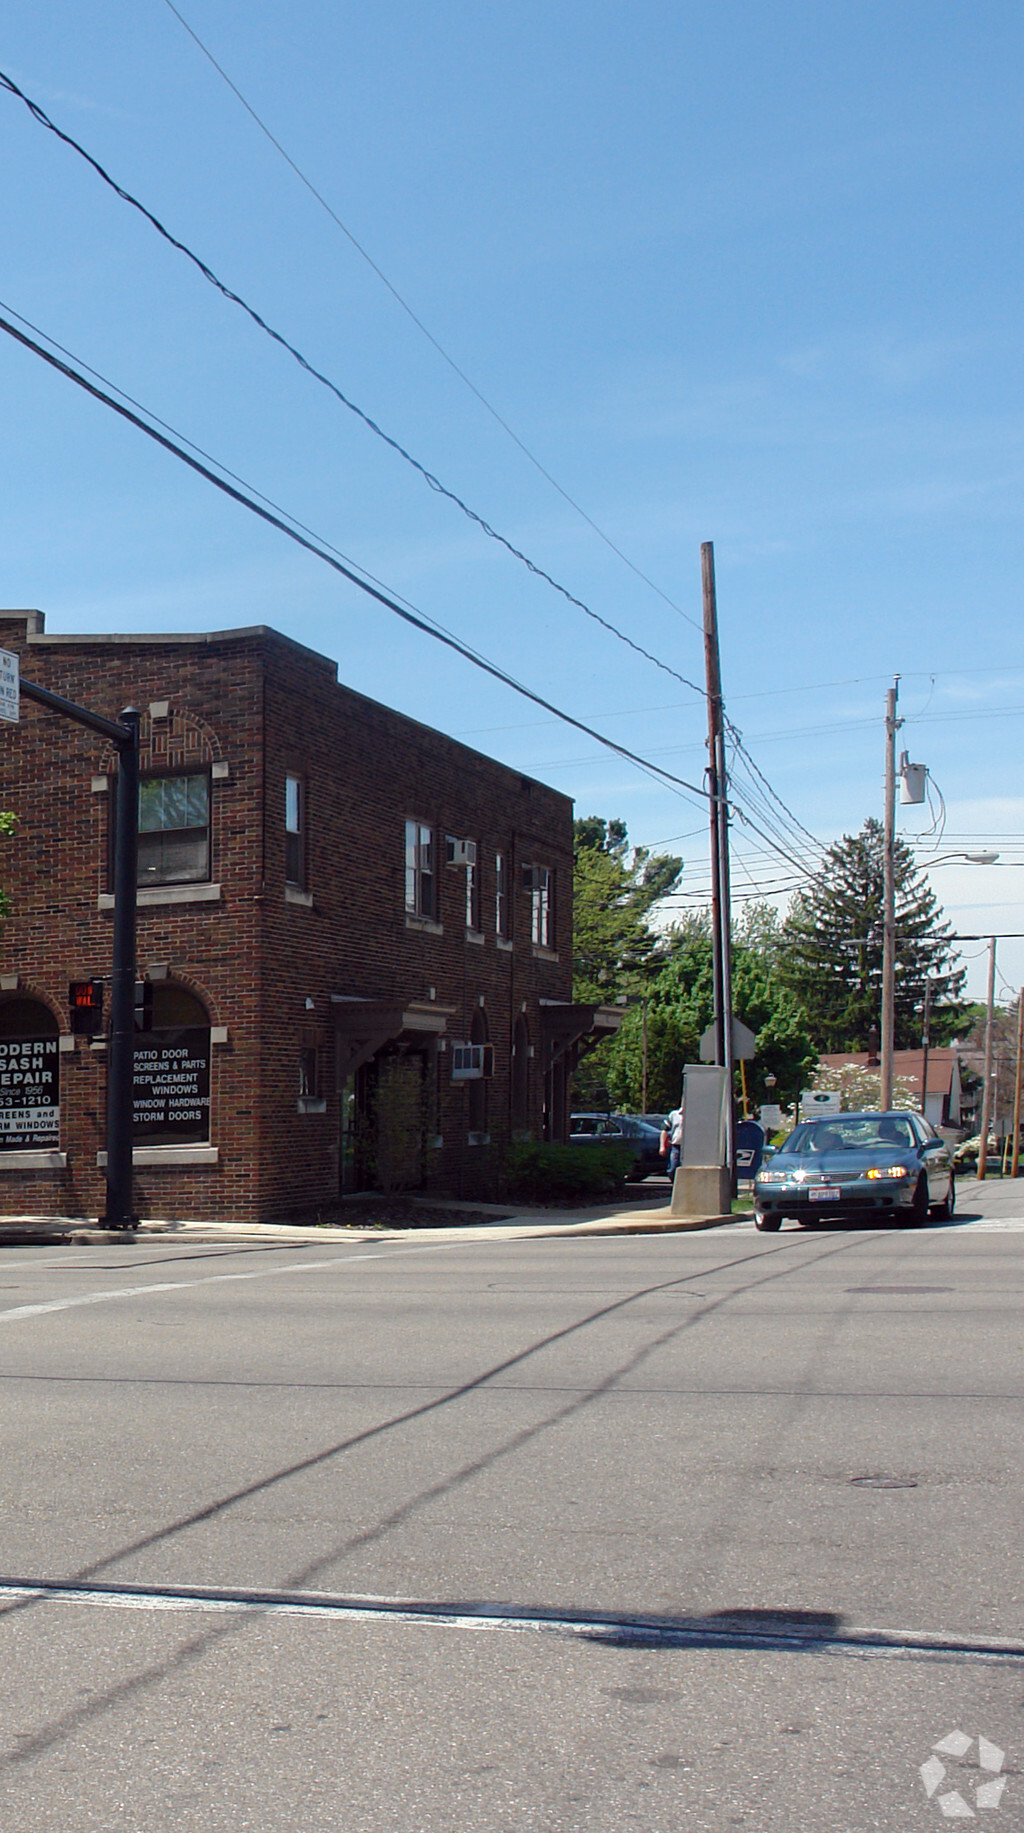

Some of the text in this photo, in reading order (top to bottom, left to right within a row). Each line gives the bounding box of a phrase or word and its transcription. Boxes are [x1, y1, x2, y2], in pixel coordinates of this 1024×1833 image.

[3, 657, 11, 668] NO
[0, 670, 15, 684] TURN
[6, 687, 17, 700] RED
[133, 1049, 189, 1060] PATIO DOOR
[133, 1059, 206, 1072] SCREENS & PARTS
[133, 1073, 198, 1084] REPLACEMENT
[0, 1087, 21, 1096] Since
[152, 1084, 199, 1095] WINDOWS
[133, 1097, 211, 1108] WINDOW HARDWARE
[36, 1109, 55, 1118] and
[133, 1110, 202, 1122] STORM DOORS
[15, 1120, 60, 1129] WINDOWS
[5, 1135, 23, 1143] Made
[24, 1134, 30, 1143] &
